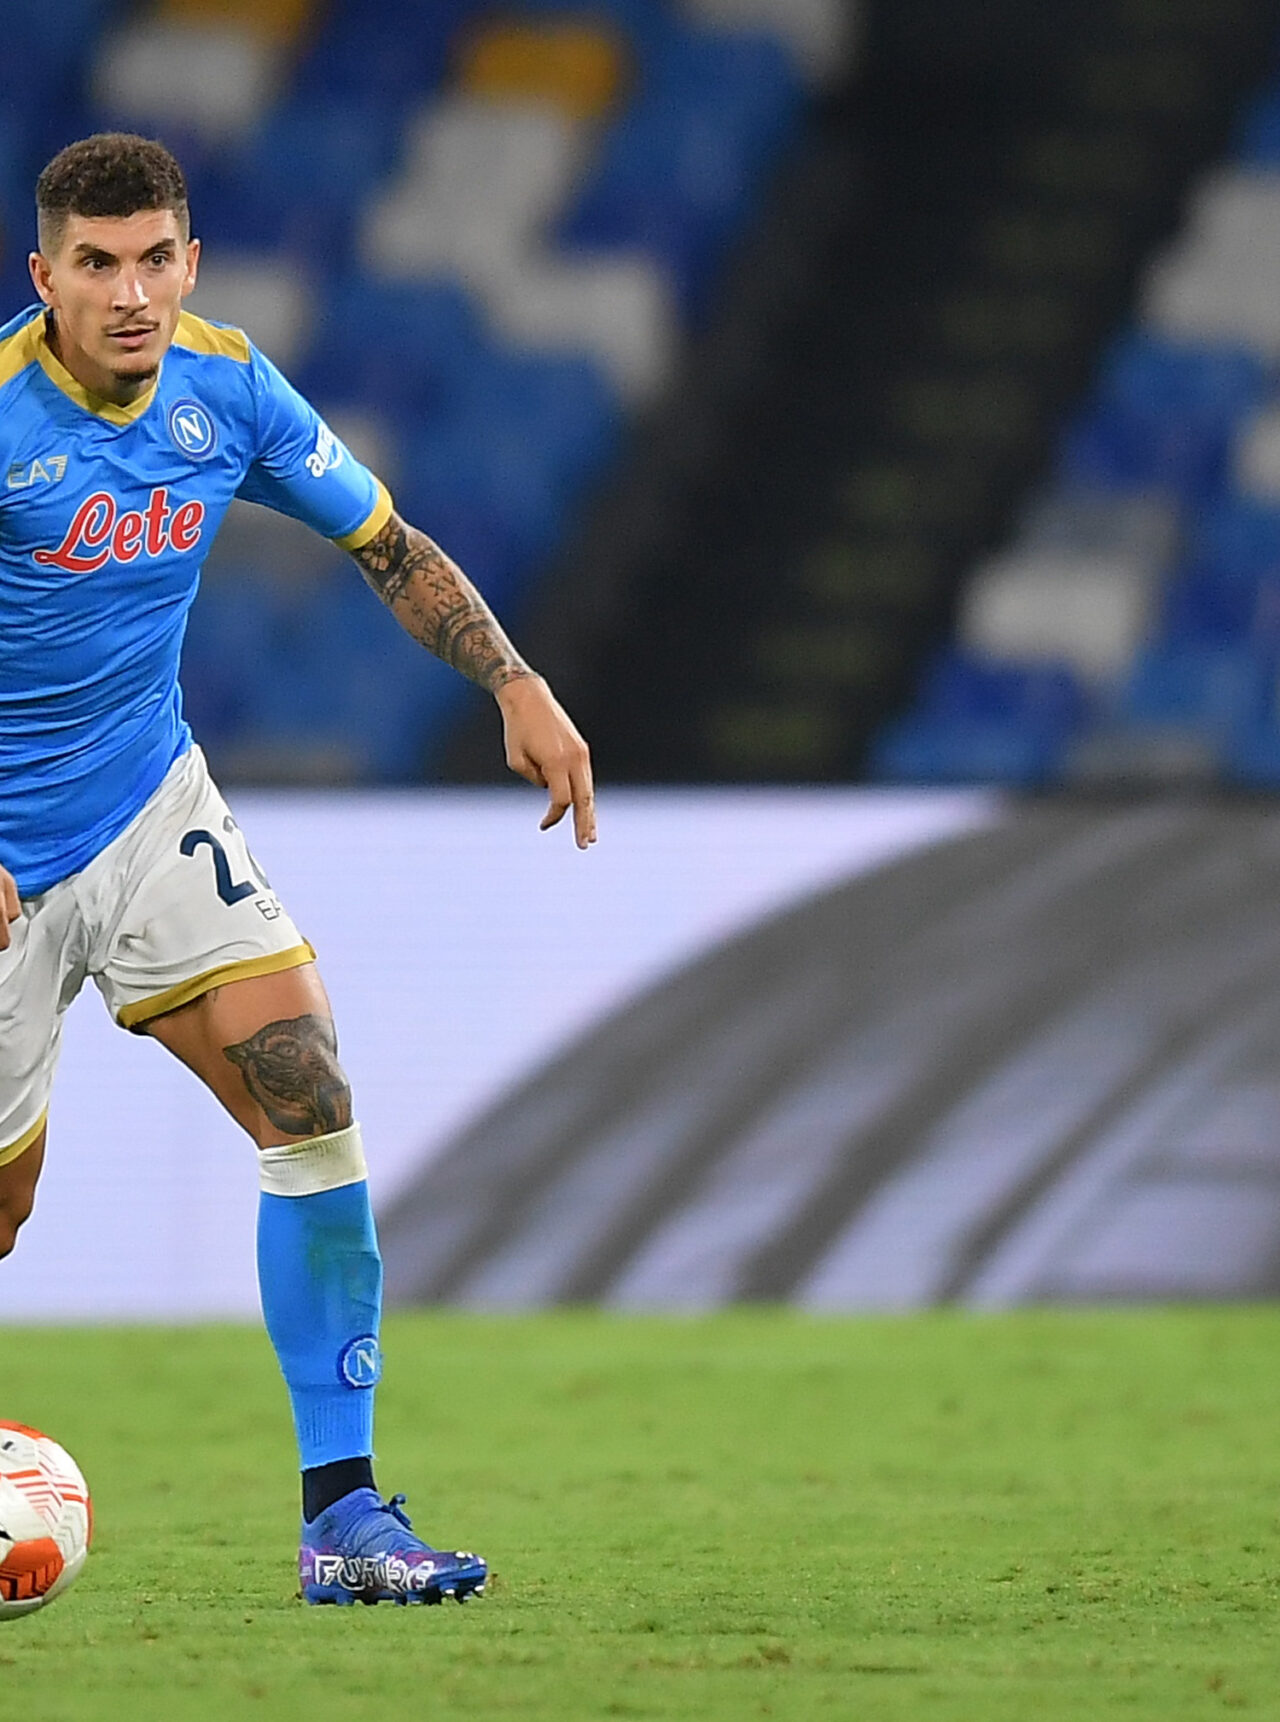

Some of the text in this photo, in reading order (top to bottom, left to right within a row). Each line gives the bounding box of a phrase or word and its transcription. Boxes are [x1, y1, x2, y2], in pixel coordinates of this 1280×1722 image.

[177, 413, 204, 444] N
[7, 455, 69, 488] EA7
[32, 487, 205, 574] Lete
[355, 1348, 377, 1378] N
